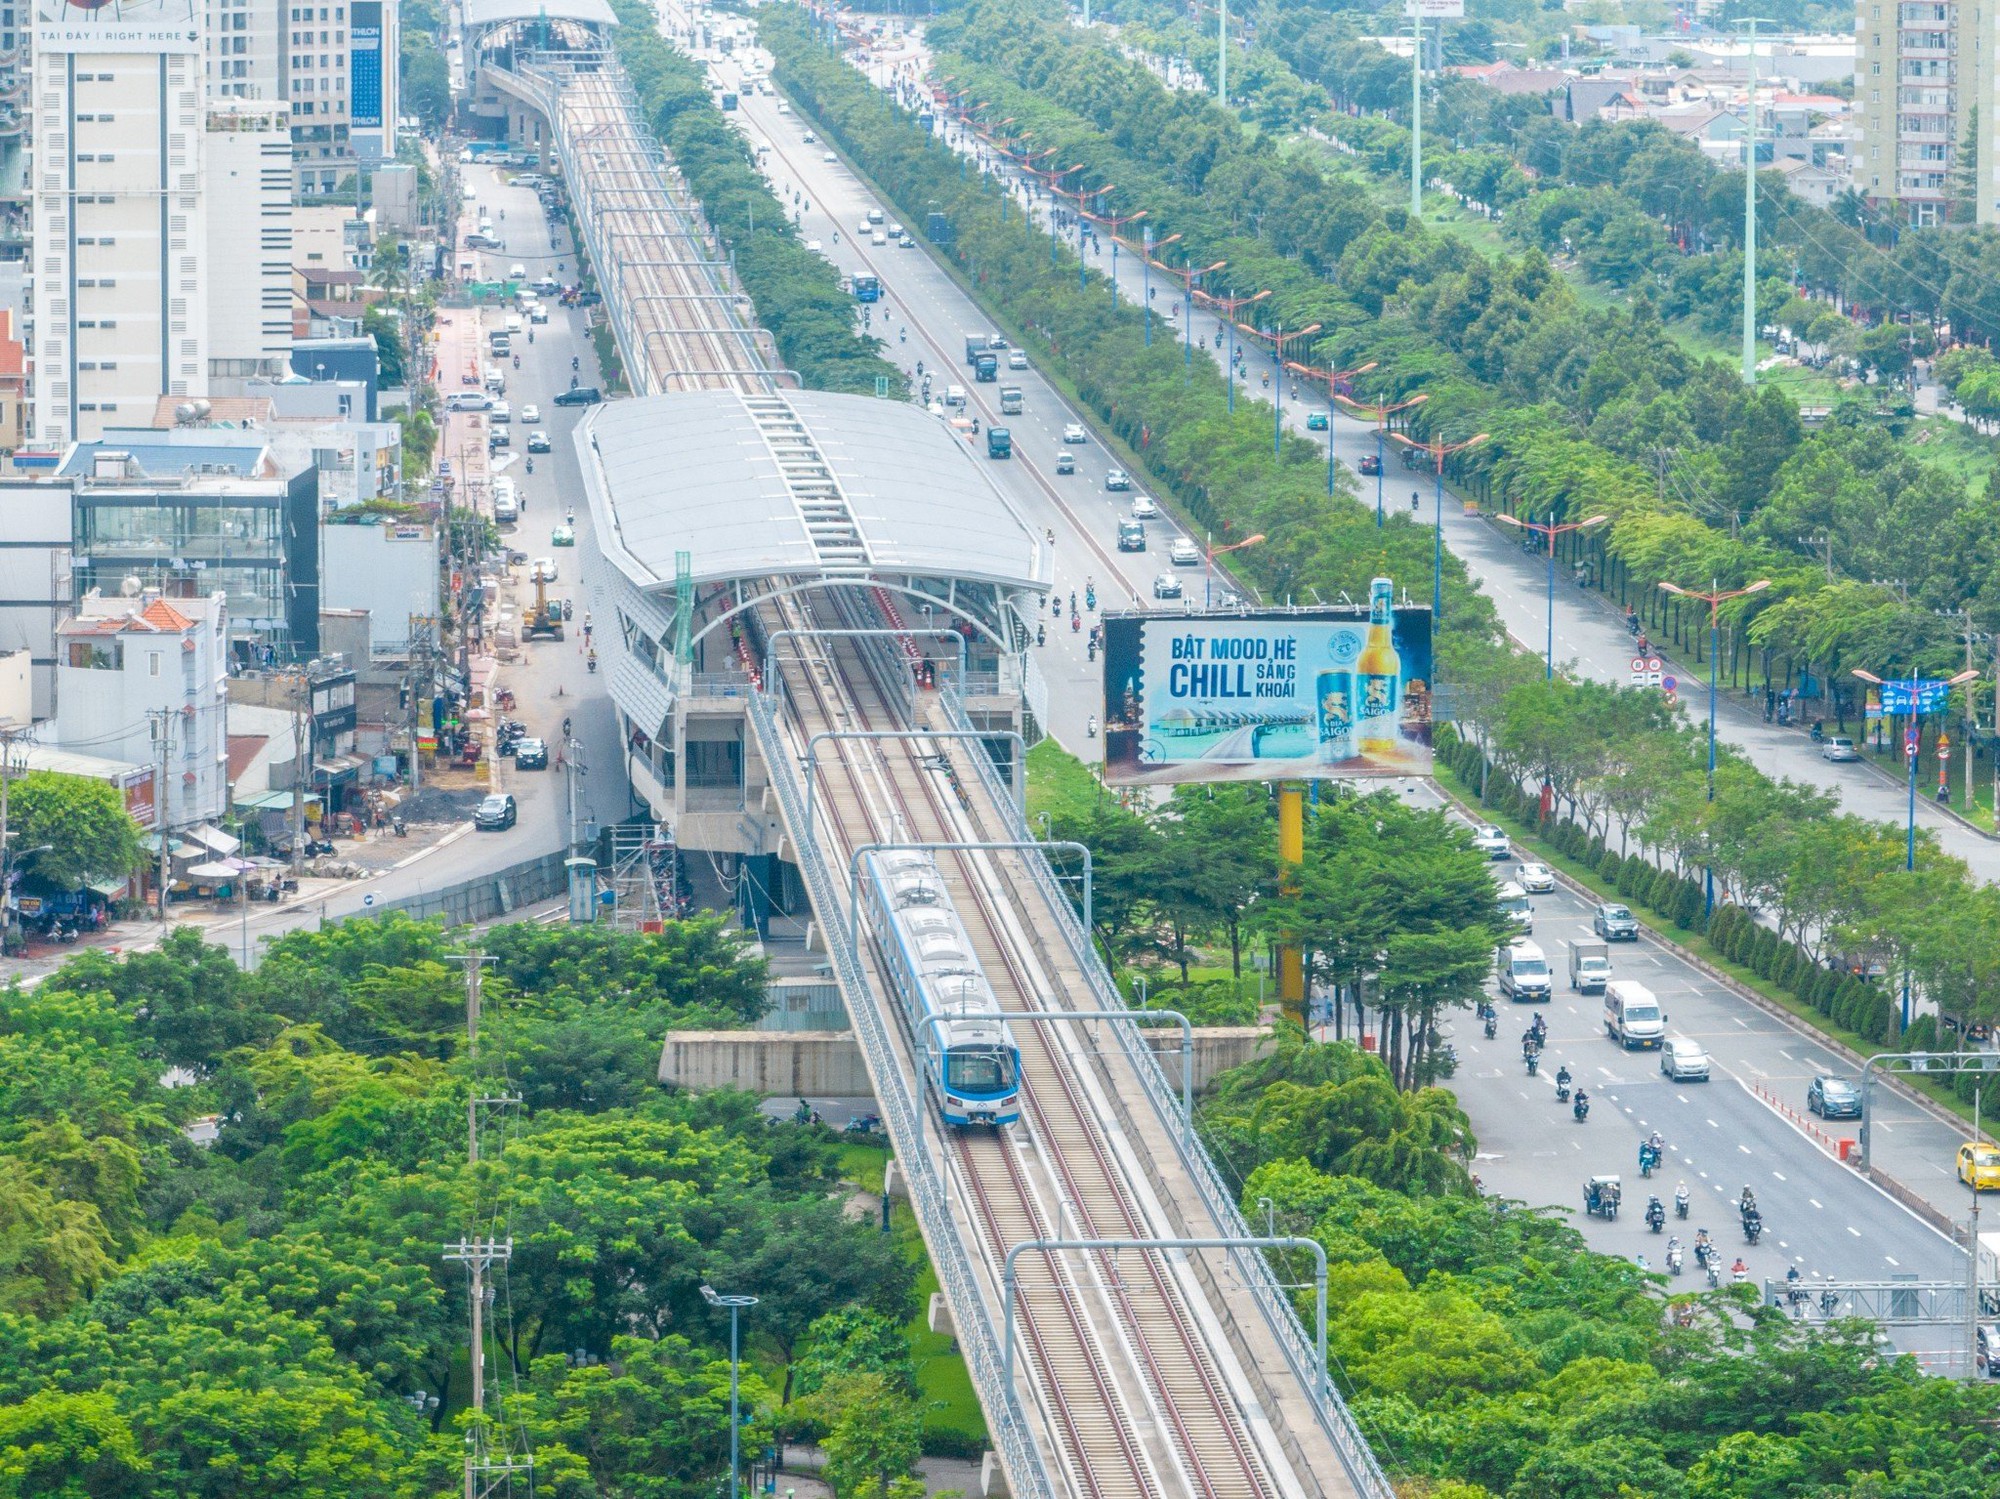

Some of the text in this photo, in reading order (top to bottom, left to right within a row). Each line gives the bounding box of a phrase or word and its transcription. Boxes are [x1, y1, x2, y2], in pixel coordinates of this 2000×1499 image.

[105, 32, 143, 40] RIGHT
[149, 32, 181, 40] HERE
[351, 27, 380, 35] THLON
[351, 116, 380, 124] THLON
[1171, 633, 1297, 663] BẬT MOOD HÈ
[1256, 658, 1296, 679] SẢNG
[1169, 663, 1252, 698] CHILL
[1256, 679, 1295, 698] KHOÁI
